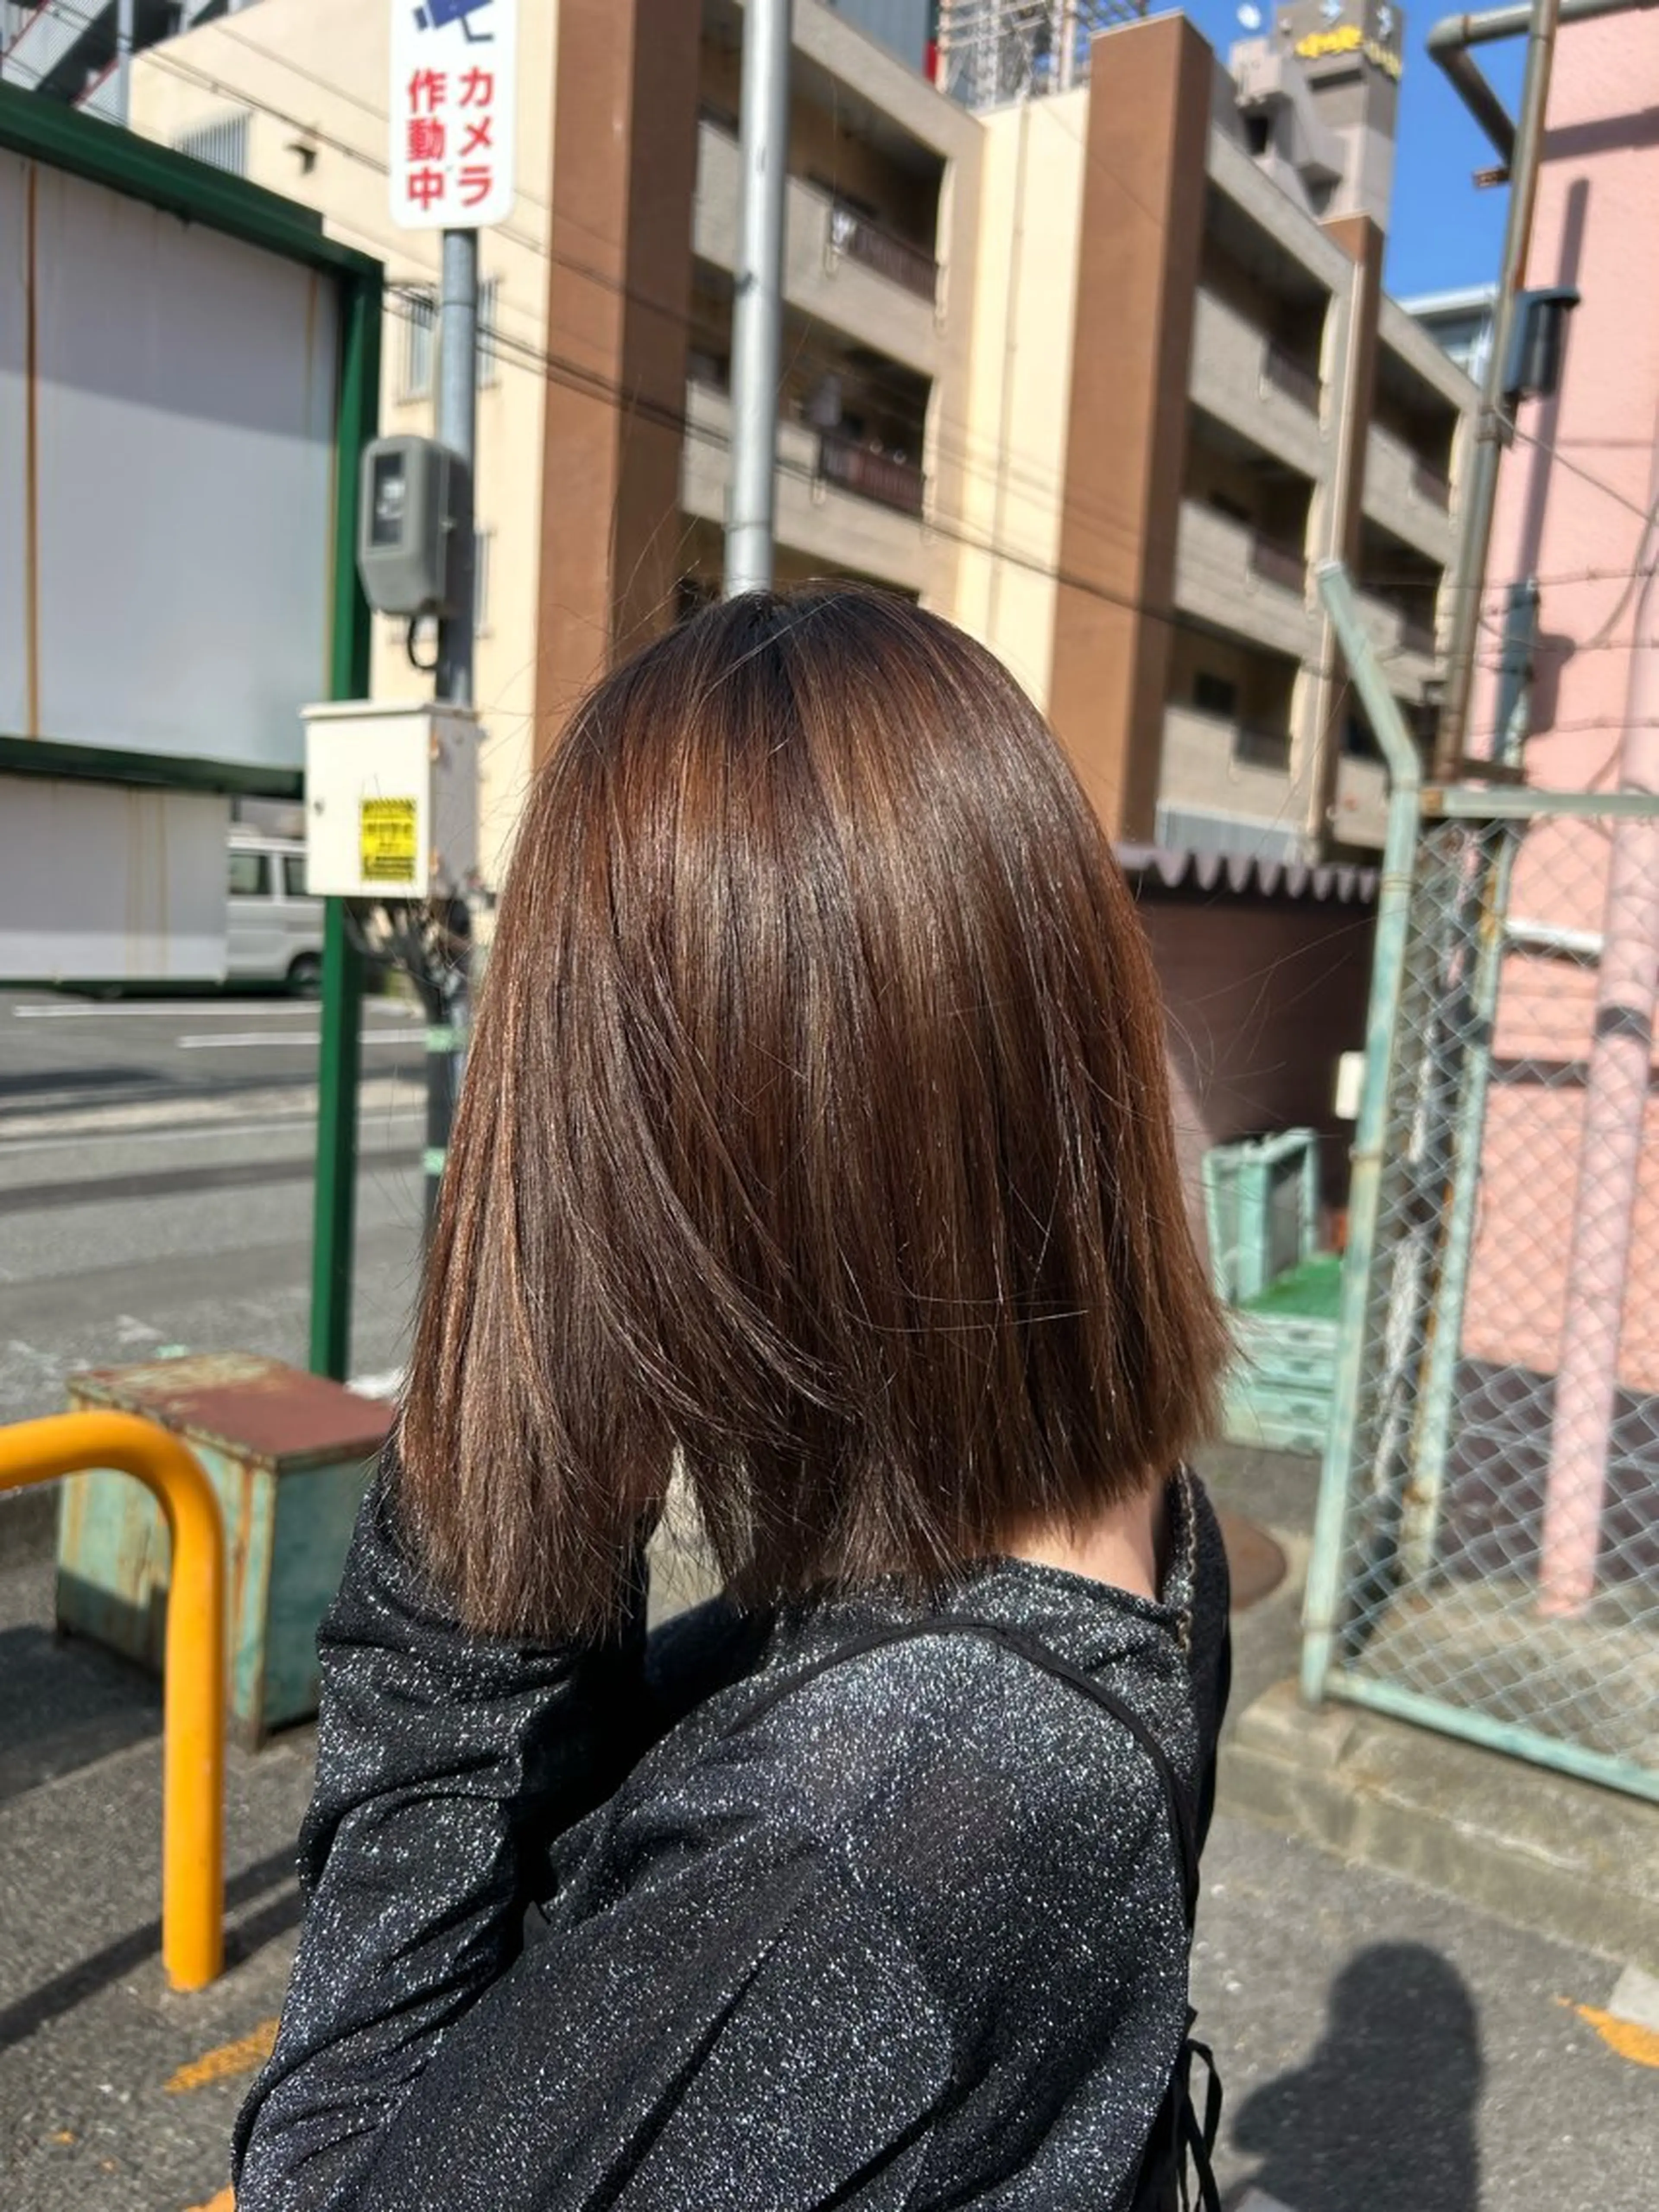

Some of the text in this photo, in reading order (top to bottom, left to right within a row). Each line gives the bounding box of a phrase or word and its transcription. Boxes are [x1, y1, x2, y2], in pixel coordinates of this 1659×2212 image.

[407, 68, 447, 210] 作動中
[458, 66, 493, 207] カメラ
